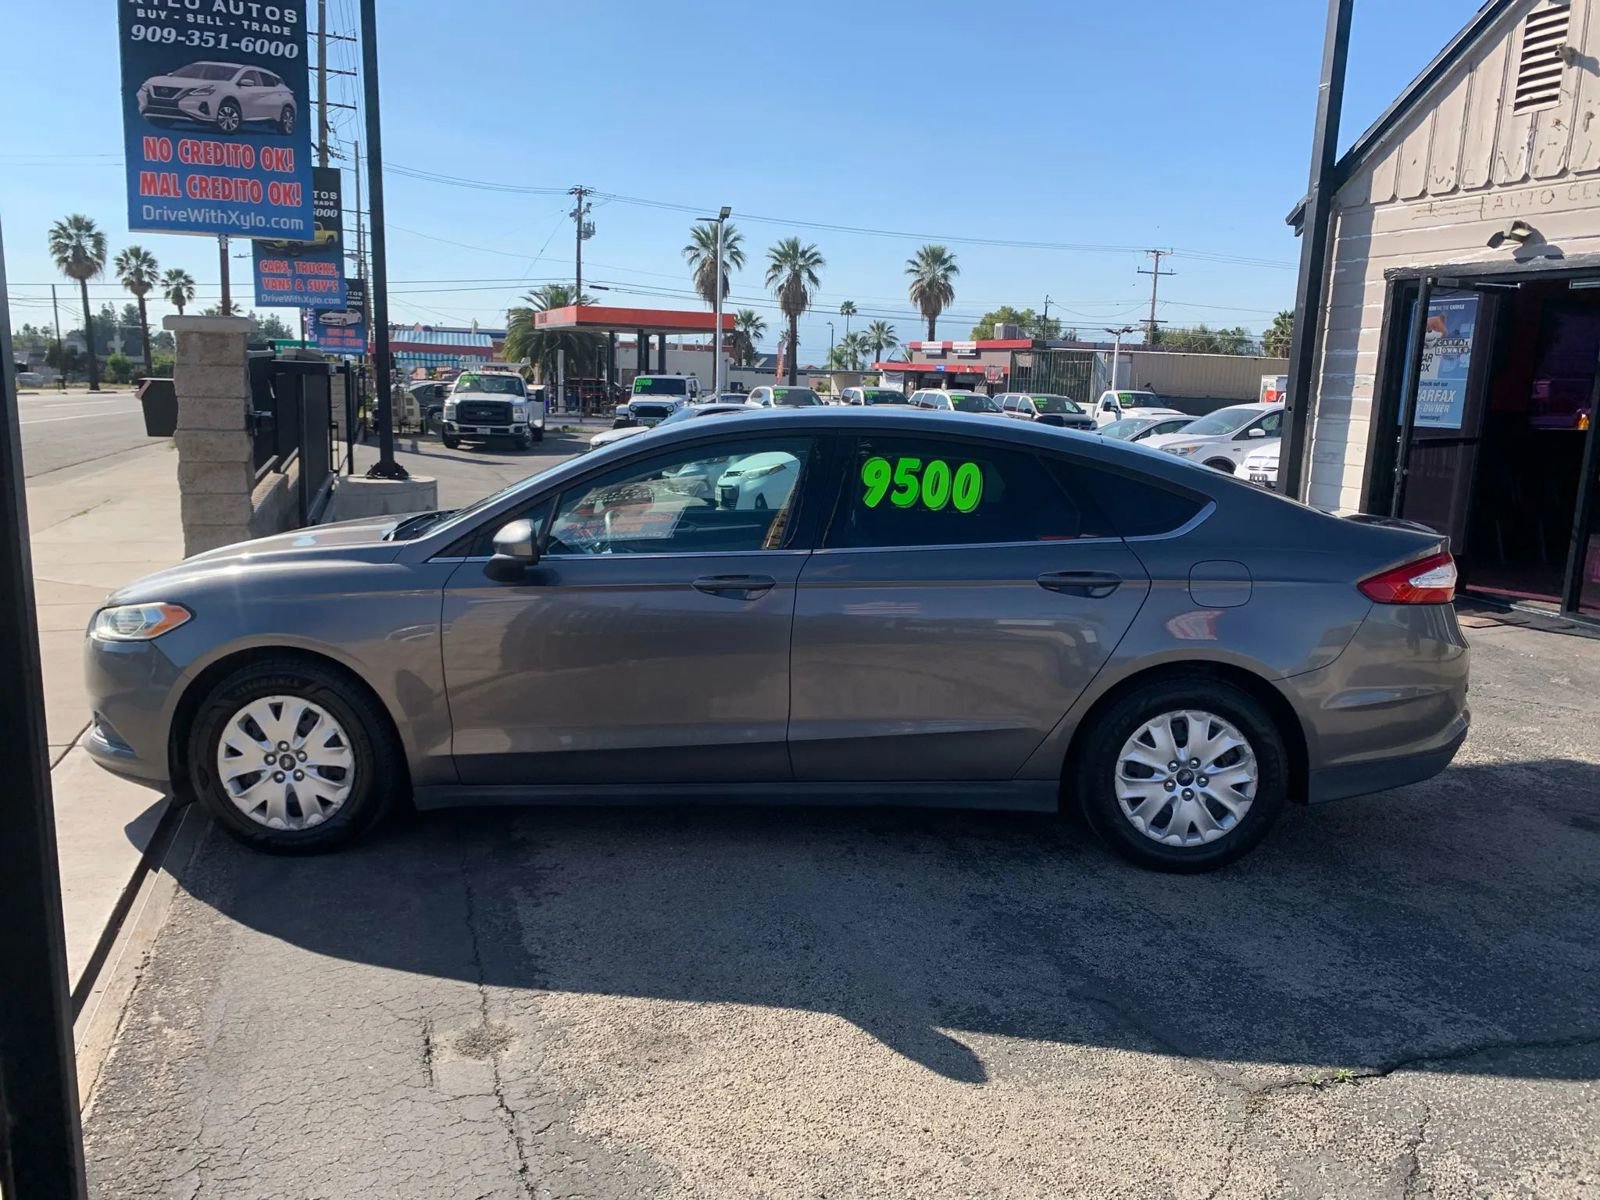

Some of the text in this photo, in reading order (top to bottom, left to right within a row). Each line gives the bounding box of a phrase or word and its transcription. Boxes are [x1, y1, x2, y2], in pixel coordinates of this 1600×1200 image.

[136, 8, 167, 20] BUY
[186, 13, 223, 26] SELL
[241, 20, 292, 36] TRADE
[212, 0, 298, 23] AUTOS
[131, 24, 299, 59] 909-351-6000
[143, 136, 295, 173] NO CREDITO OK!
[139, 170, 303, 208] MAL CREDITO OK!
[312, 190, 338, 200] TOS
[142, 205, 304, 231] DriveWithXylo.com
[259, 259, 340, 279] CARS, TRUCKS,
[262, 277, 339, 294] VANS & SUV'S
[261, 294, 341, 306] DriveWithXylo.com
[1420, 363, 1431, 372] OX
[1422, 353, 1434, 363] AR
[861, 456, 984, 514] 9500
